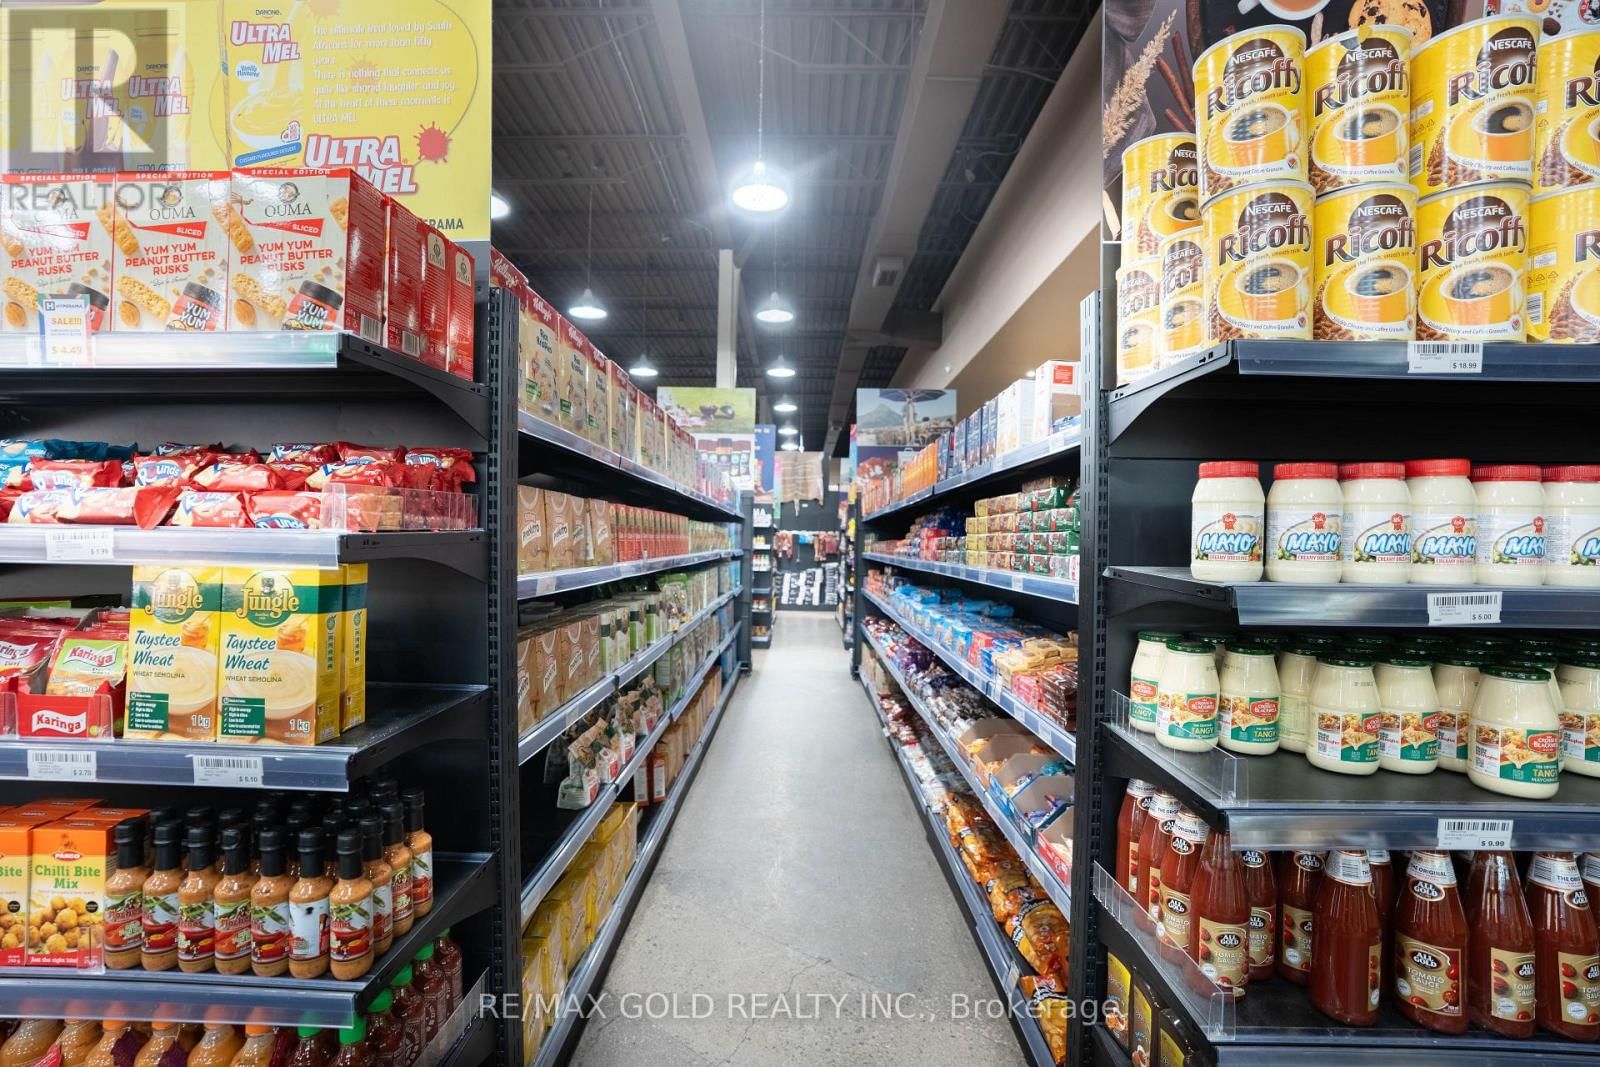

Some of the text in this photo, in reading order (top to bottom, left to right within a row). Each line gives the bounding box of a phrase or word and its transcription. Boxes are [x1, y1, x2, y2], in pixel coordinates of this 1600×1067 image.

[231, 20, 292, 47] ULTRA
[262, 41, 300, 64] MEL
[350, 67, 382, 80] nothing
[1448, 50, 1536, 107] Ricof
[61, 78, 113, 100] ULTRA
[128, 75, 182, 99] ULTRA
[1206, 55, 1302, 121] Ricoffy
[1314, 58, 1410, 117] Ricoffy
[86, 97, 122, 119] MEL
[153, 95, 191, 118] MEL
[304, 133, 402, 169] ULTRA
[251, 168, 289, 176] SPECIAL
[150, 206, 197, 221] OUMA
[264, 204, 313, 218] OUMA
[176, 226, 203, 236] SLICED
[292, 223, 320, 235] SLICED
[258, 239, 314, 253] YUM YUM
[1218, 213, 1312, 267] Ricoffy
[1420, 215, 1528, 273] Ricoffy
[143, 243, 198, 256] YUM YUM
[240, 248, 334, 266] PEANUT BUTTER
[11, 251, 100, 269] PEANUT BUTTER
[125, 250, 216, 268] PEANUT BUTTER
[37, 264, 73, 276] RUSKS
[152, 264, 190, 276] RUSKS
[186, 302, 212, 321] YUM
[301, 299, 330, 320] YUM
[296, 310, 325, 331] YUM
[1200, 531, 1260, 554] MAYO
[1285, 531, 1342, 554] MAYO
[144, 586, 204, 615] Jungle
[236, 587, 300, 618] Jungle
[134, 630, 182, 648] Taystee
[225, 634, 277, 653] Taystee
[70, 646, 113, 667] Karinga
[132, 651, 175, 667] Wheat
[224, 654, 270, 671] Wheat
[36, 713, 82, 733] Karinga
[297, 720, 311, 732] kg
[1191, 726, 1215, 736] TANGY
[1242, 855, 1263, 864] GOLD
[1299, 859, 1320, 868] GOLD
[1302, 854, 1316, 862] ALL
[35, 864, 101, 877] Chilli Bite
[54, 878, 78, 889] Mix
[1413, 885, 1438, 898] GOLD
[1417, 880, 1435, 892] ALL
[1219, 938, 1240, 946] GOLD
[1413, 956, 1438, 968] GOLD
[1416, 951, 1434, 963] ALL
[1407, 966, 1445, 984] TOMATO
[1411, 974, 1441, 990] SAUCE
